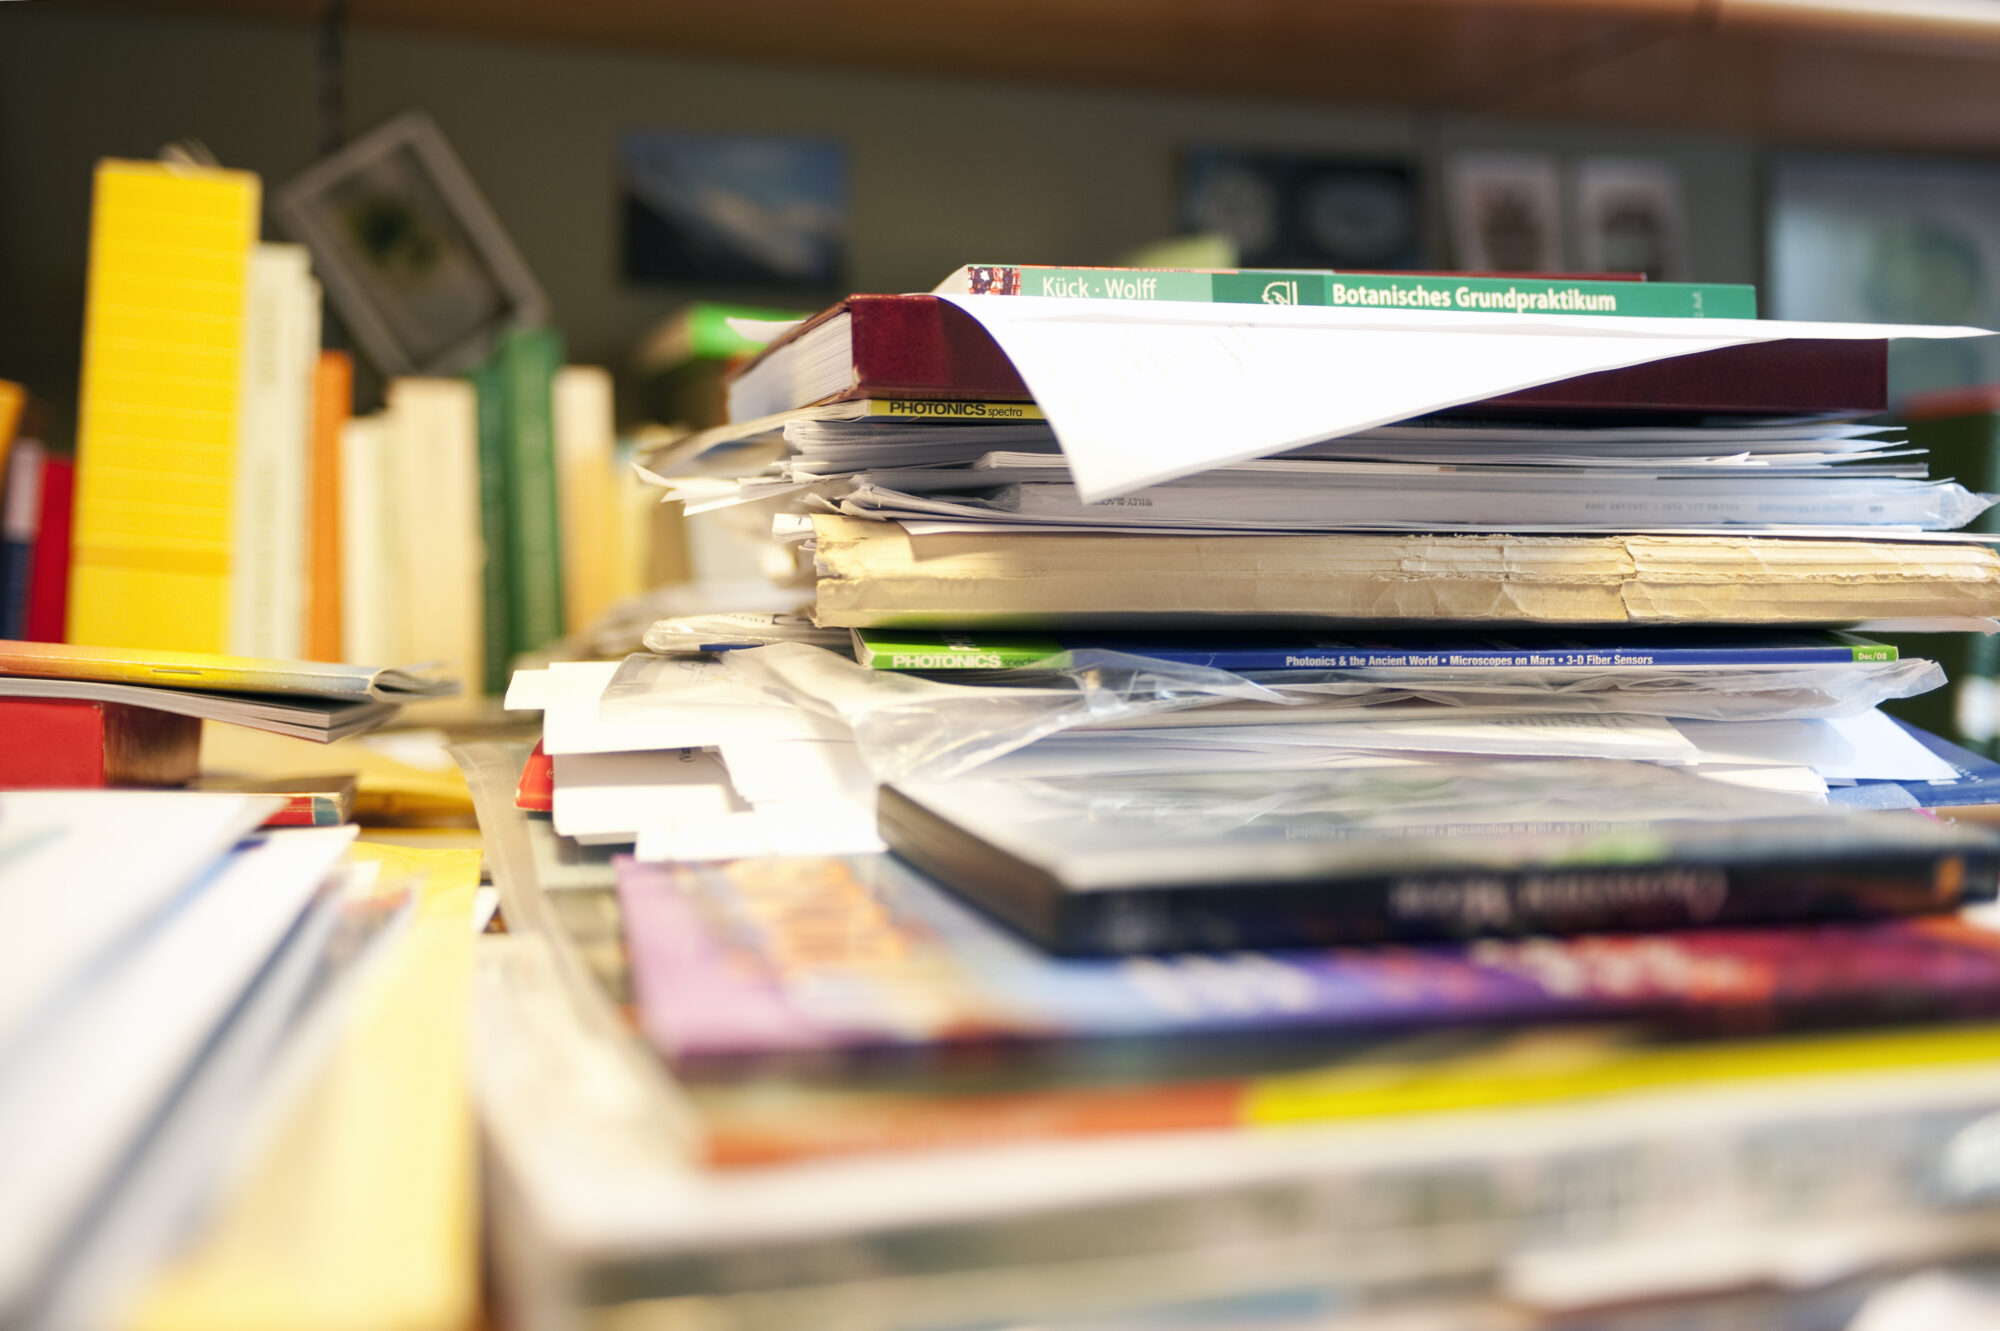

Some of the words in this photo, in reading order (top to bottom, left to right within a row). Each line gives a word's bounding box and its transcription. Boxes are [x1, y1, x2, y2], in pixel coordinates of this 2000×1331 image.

[1043, 276, 1090, 298] Kück
[1104, 278, 1157, 299] Wolff
[1333, 283, 1451, 307] Botanisches
[1455, 286, 1616, 313] Grundpraktikum
[890, 401, 986, 416] PHOTONICS
[988, 407, 1023, 418] spectra
[893, 655, 1001, 668] PHOTONICS
[1286, 656, 1336, 666] Photonics
[1339, 656, 1347, 666] &
[1350, 656, 1366, 666] the
[1369, 656, 1406, 666] Ancient
[1409, 655, 1438, 666] World
[1450, 655, 1512, 667] Microscopes
[1515, 657, 1528, 666] on
[1530, 655, 1555, 666] Mars
[1567, 655, 1584, 665] 3-D
[1587, 655, 1611, 665] Fiber
[1614, 654, 1653, 665] Sensors
[1858, 652, 1887, 661] Dec/08
